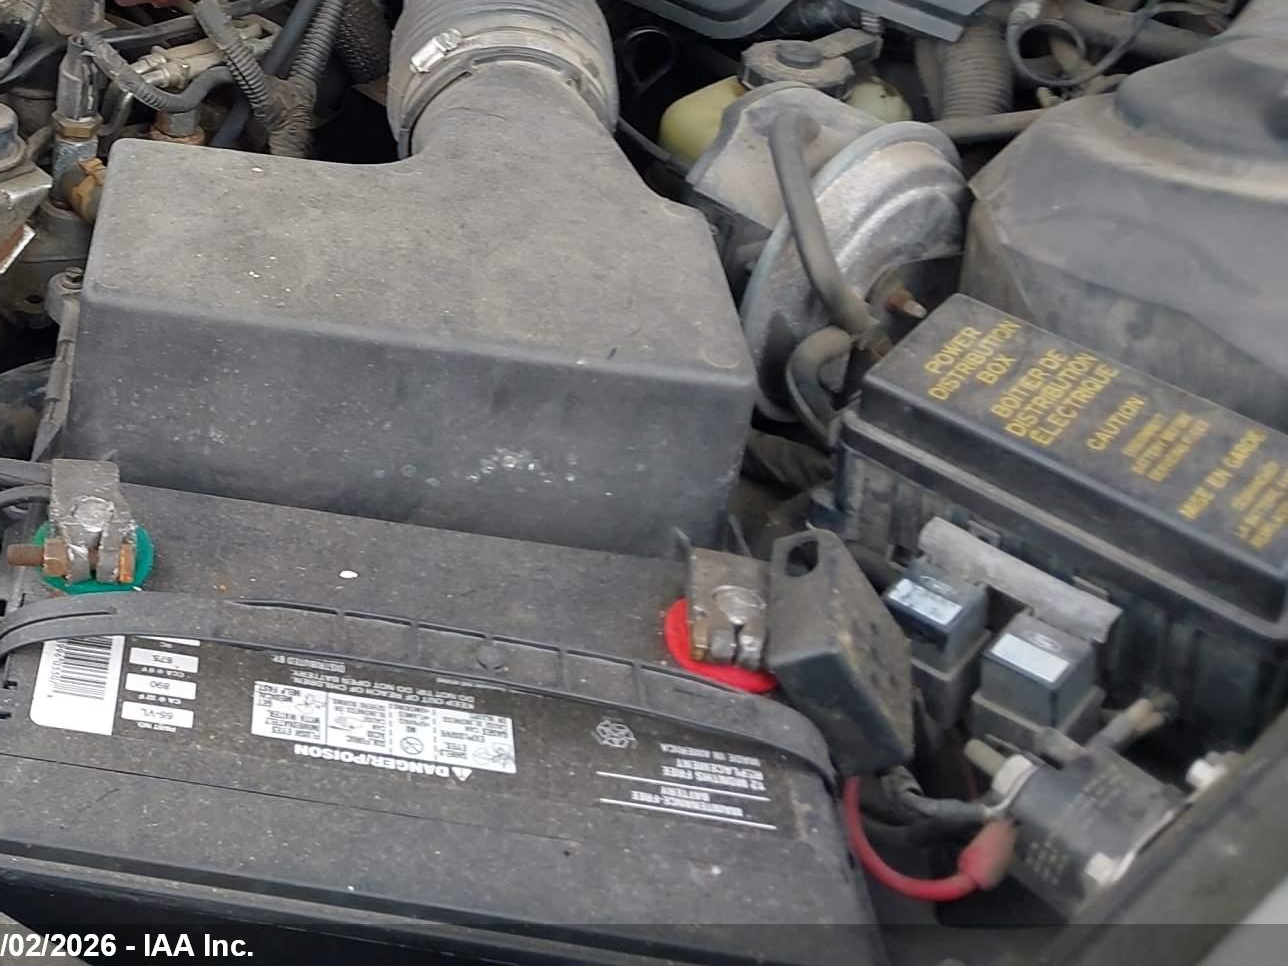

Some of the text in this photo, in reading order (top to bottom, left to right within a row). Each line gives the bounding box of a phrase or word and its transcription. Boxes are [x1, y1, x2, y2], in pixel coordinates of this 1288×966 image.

[924, 326, 982, 374] POWER
[927, 320, 1022, 401] DISTRIBUTION
[1040, 348, 1068, 371] DE
[976, 354, 1016, 385] BOX
[1005, 352, 1099, 438] DISTRIBUTION
[1086, 395, 1146, 451] CAUTION
[340, 675, 372, 689] OPEN
[347, 684, 365, 694] OF
[371, 680, 395, 692] NOT
[395, 684, 414, 694] DO
[365, 686, 403, 700] REACH
[404, 692, 420, 702] OF
[420, 694, 444, 706] OUT
[434, 689, 457, 700] NOT
[457, 693, 475, 703] DO
[445, 698, 475, 710] KEEP
[294, 743, 450, 777] DANGER/POISON
